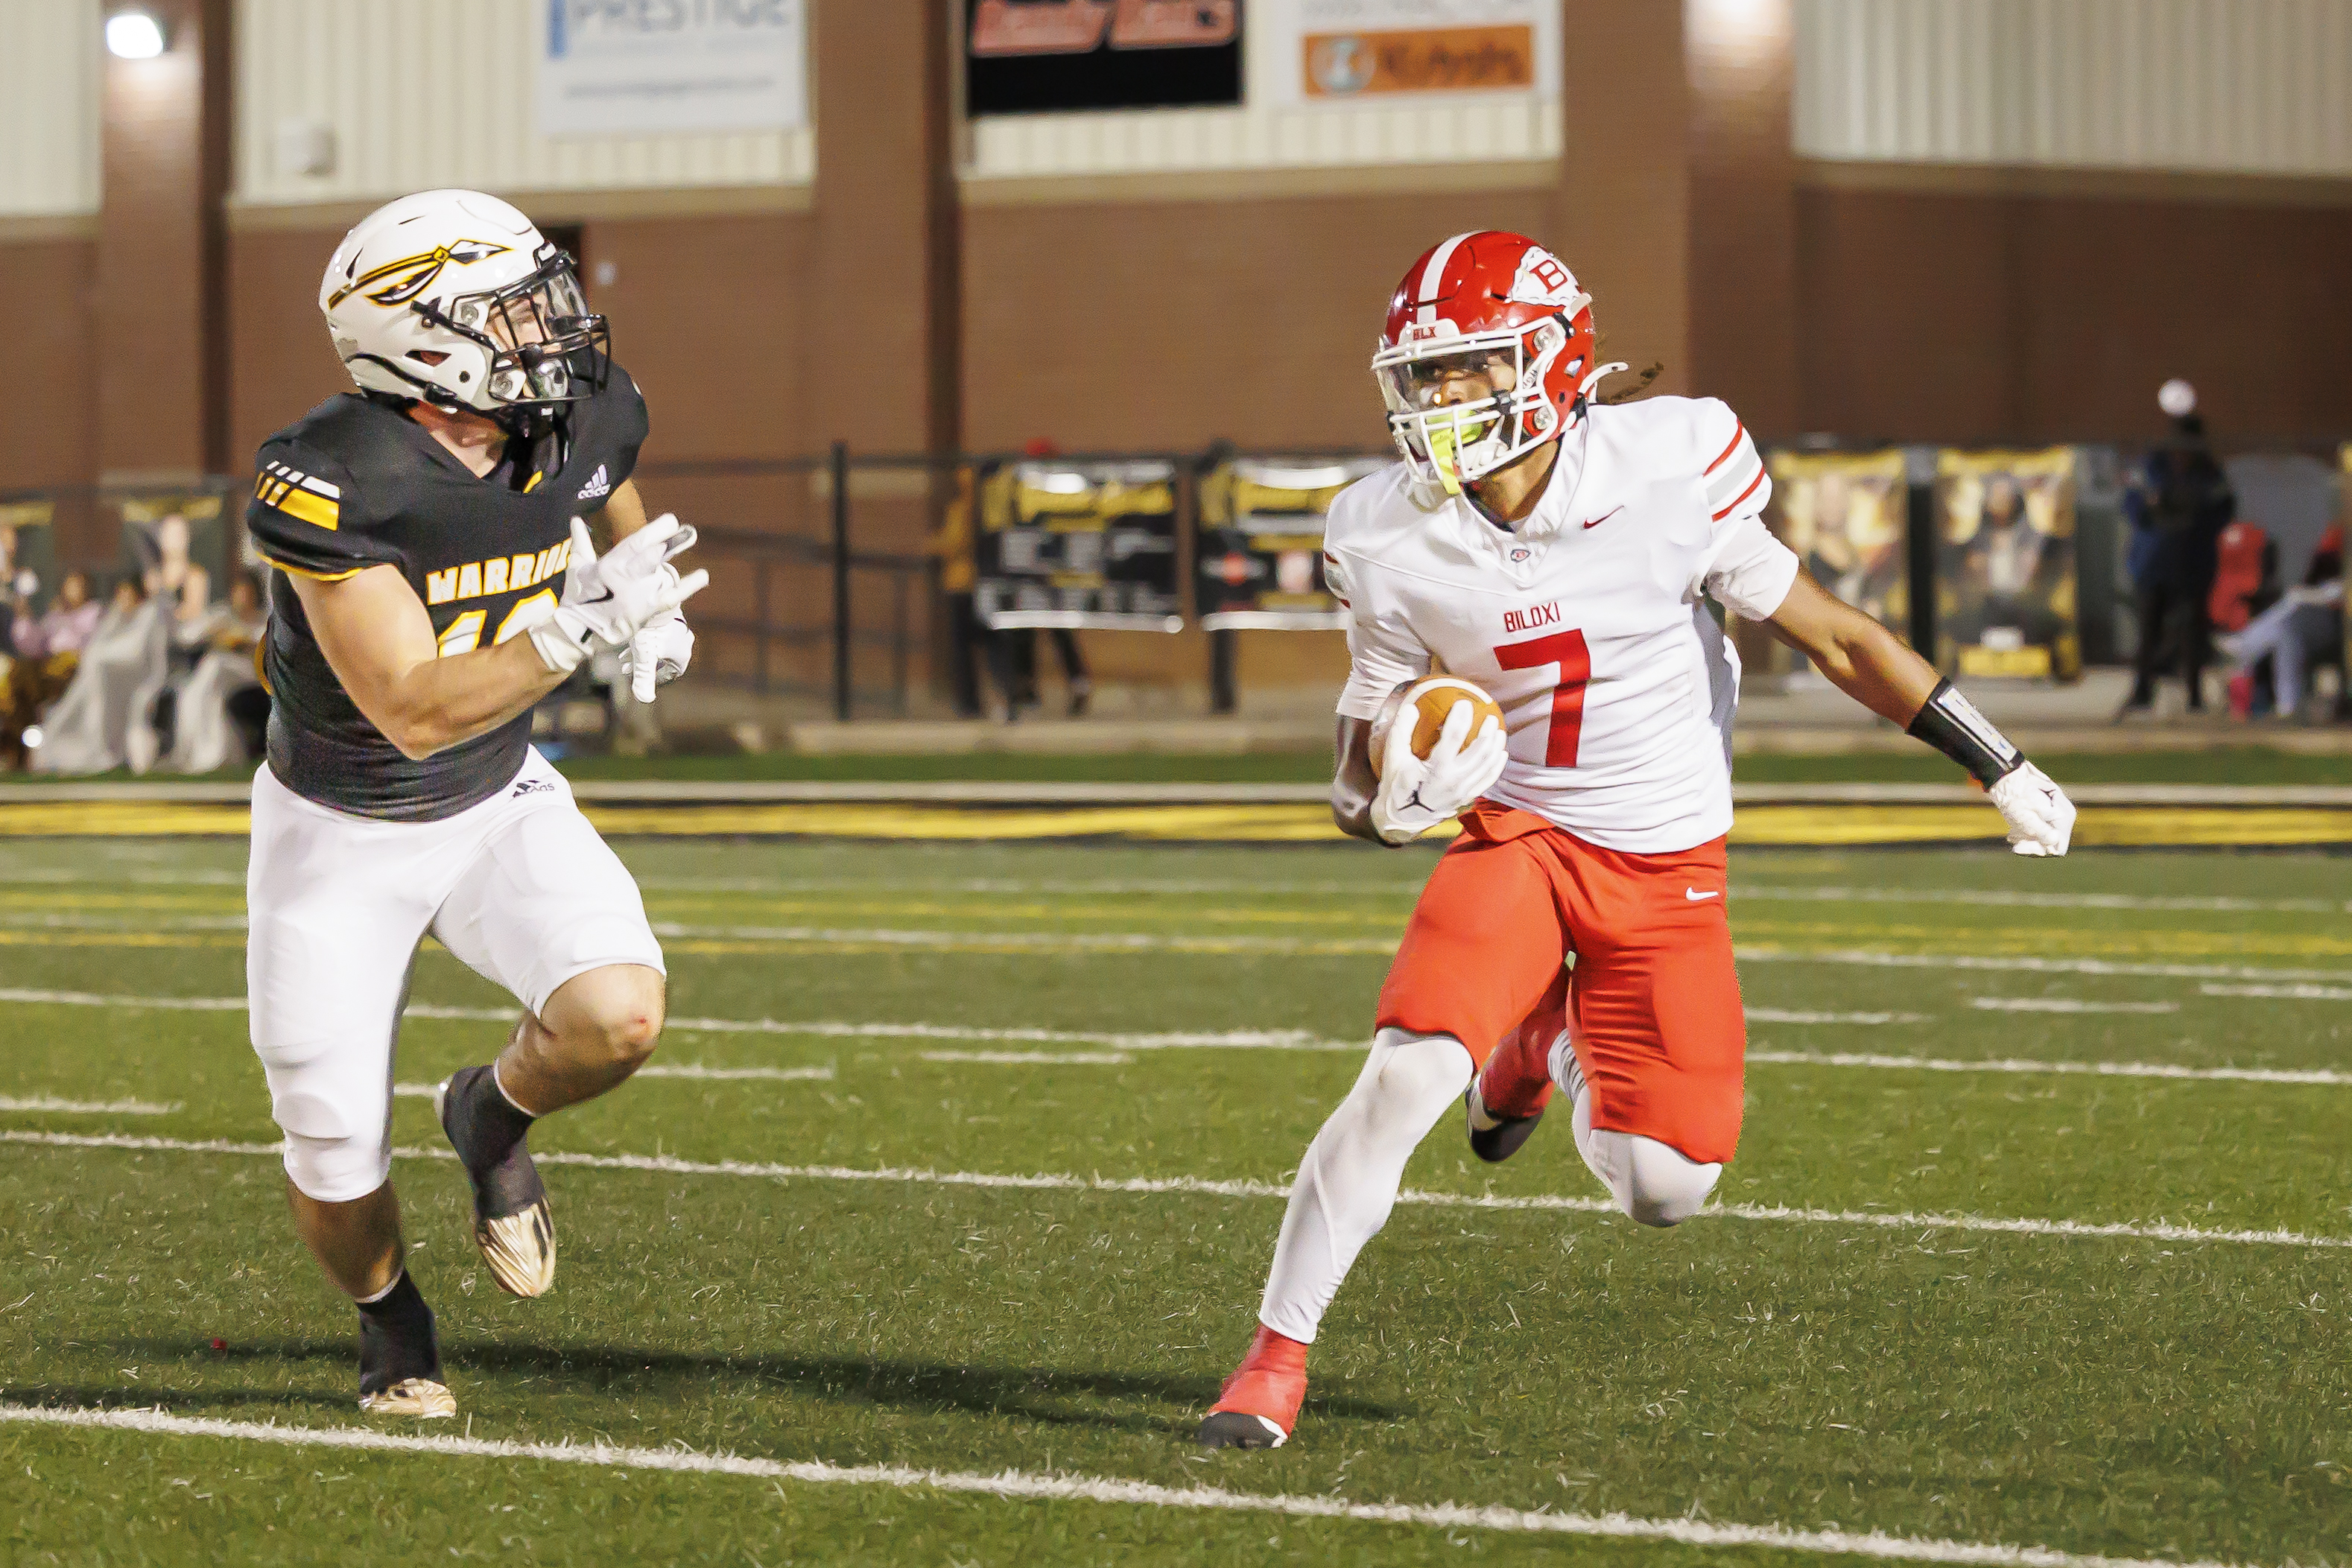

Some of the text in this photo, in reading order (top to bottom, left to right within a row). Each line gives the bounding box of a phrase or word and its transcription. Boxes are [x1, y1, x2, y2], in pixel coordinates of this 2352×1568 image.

[1530, 260, 1568, 295] B
[1503, 601, 1560, 632] BILOXI
[1493, 628, 1591, 767] 7
